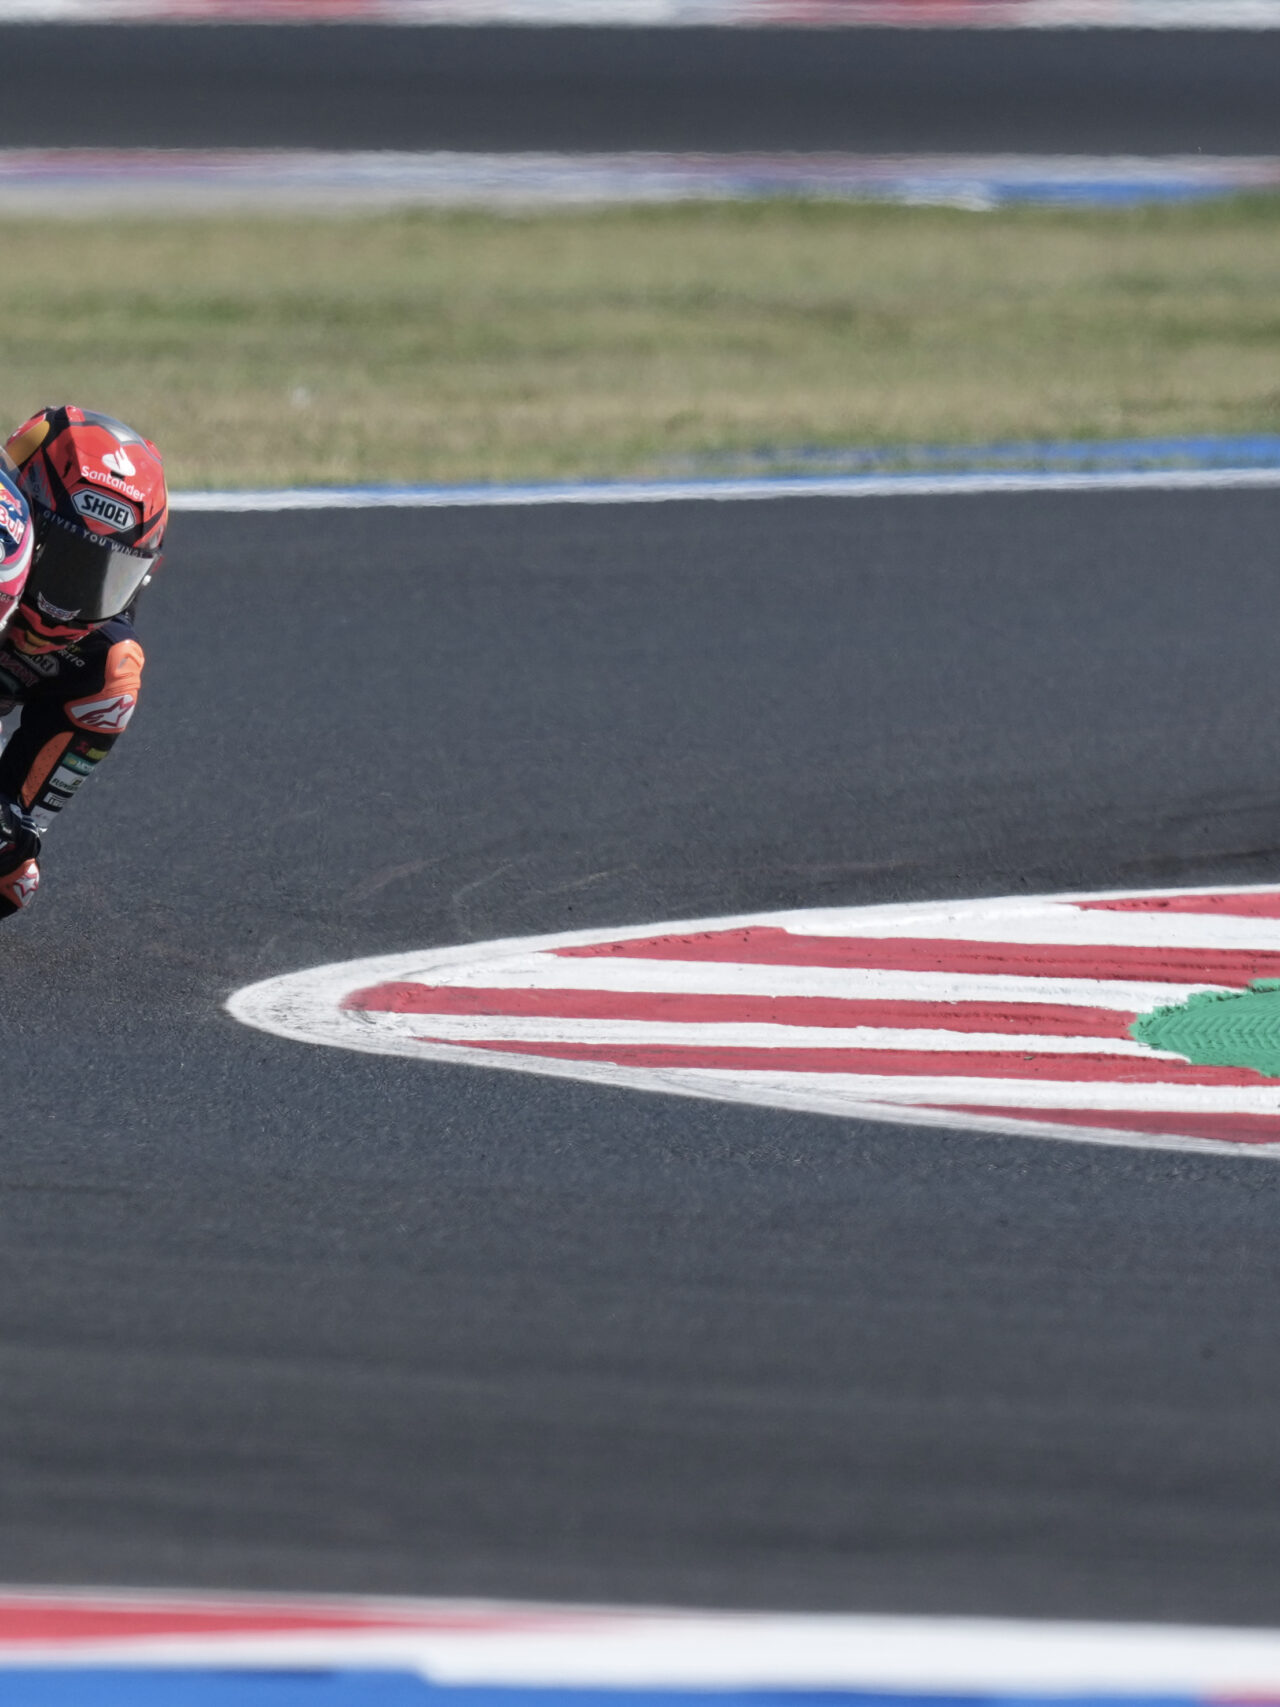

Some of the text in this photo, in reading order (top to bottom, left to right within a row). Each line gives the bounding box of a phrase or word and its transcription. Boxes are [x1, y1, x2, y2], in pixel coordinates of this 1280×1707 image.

[80, 465, 147, 502] Santander
[80, 493, 130, 527] SHOEI
[42, 509, 145, 560] GIVES YOU WINGS
